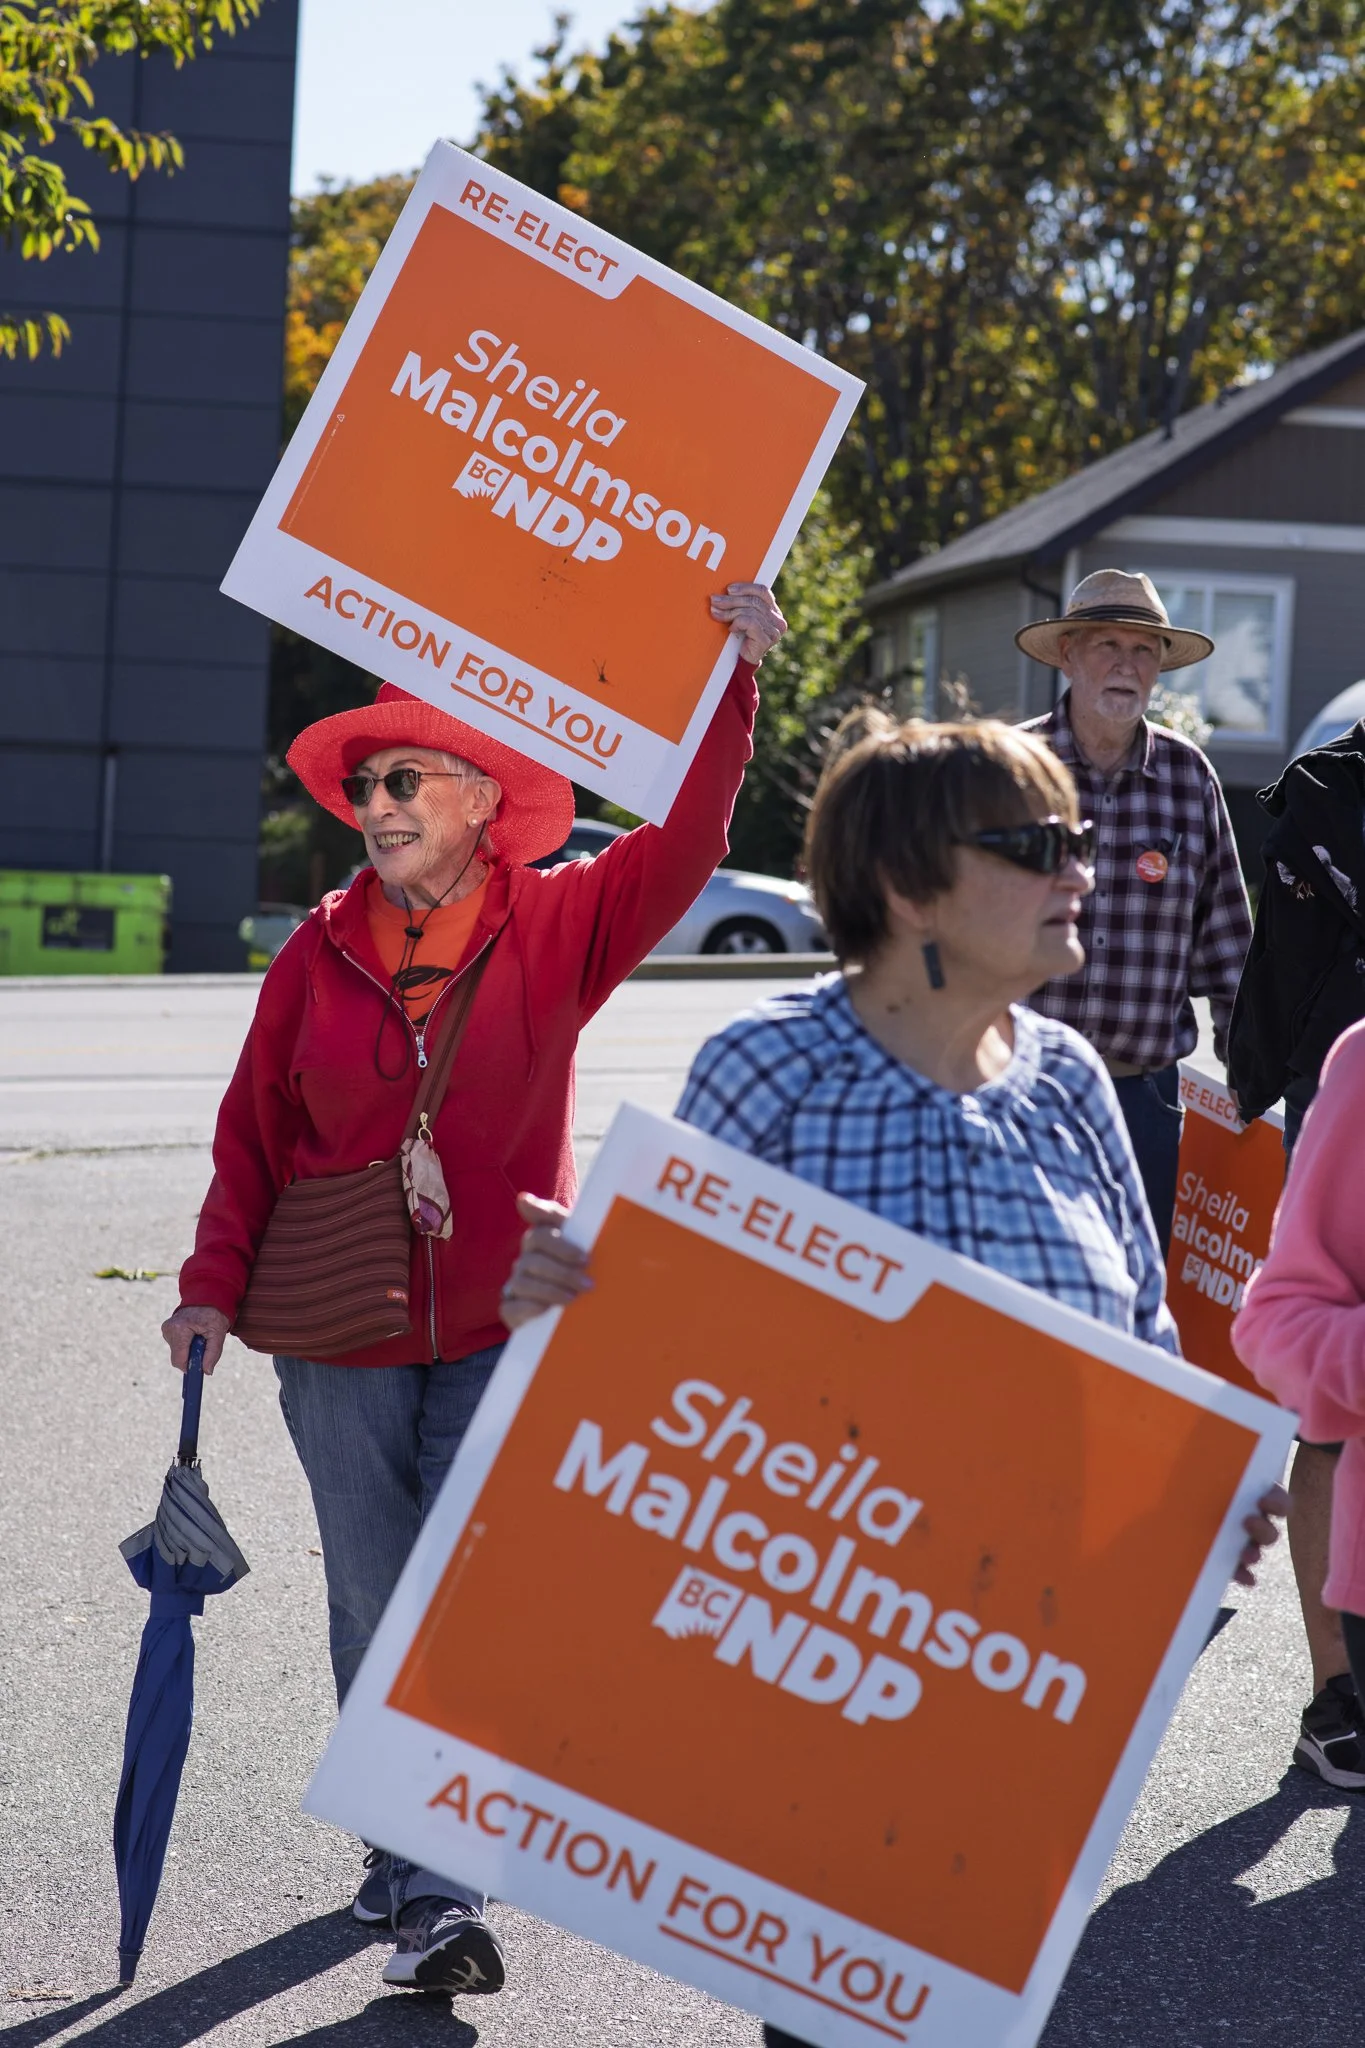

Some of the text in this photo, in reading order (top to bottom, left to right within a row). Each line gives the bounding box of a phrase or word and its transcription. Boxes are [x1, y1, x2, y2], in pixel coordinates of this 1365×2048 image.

[459, 179, 619, 283] RE-ELECT
[454, 329, 627, 447] Sheila
[390, 351, 727, 572] Malcolmson
[467, 458, 623, 564] BC NDP
[303, 575, 623, 760] ACTION FOR YOU
[656, 1154, 904, 1296] RE-ELECT
[1173, 1203, 1266, 1280] alcolm
[1177, 1171, 1249, 1233] Sheila
[651, 1379, 923, 1546] Sheila
[553, 1419, 1087, 1725] Malcolmson
[677, 1578, 923, 1726] BC NDP
[427, 1772, 931, 2025] ACTION FOR YOU
